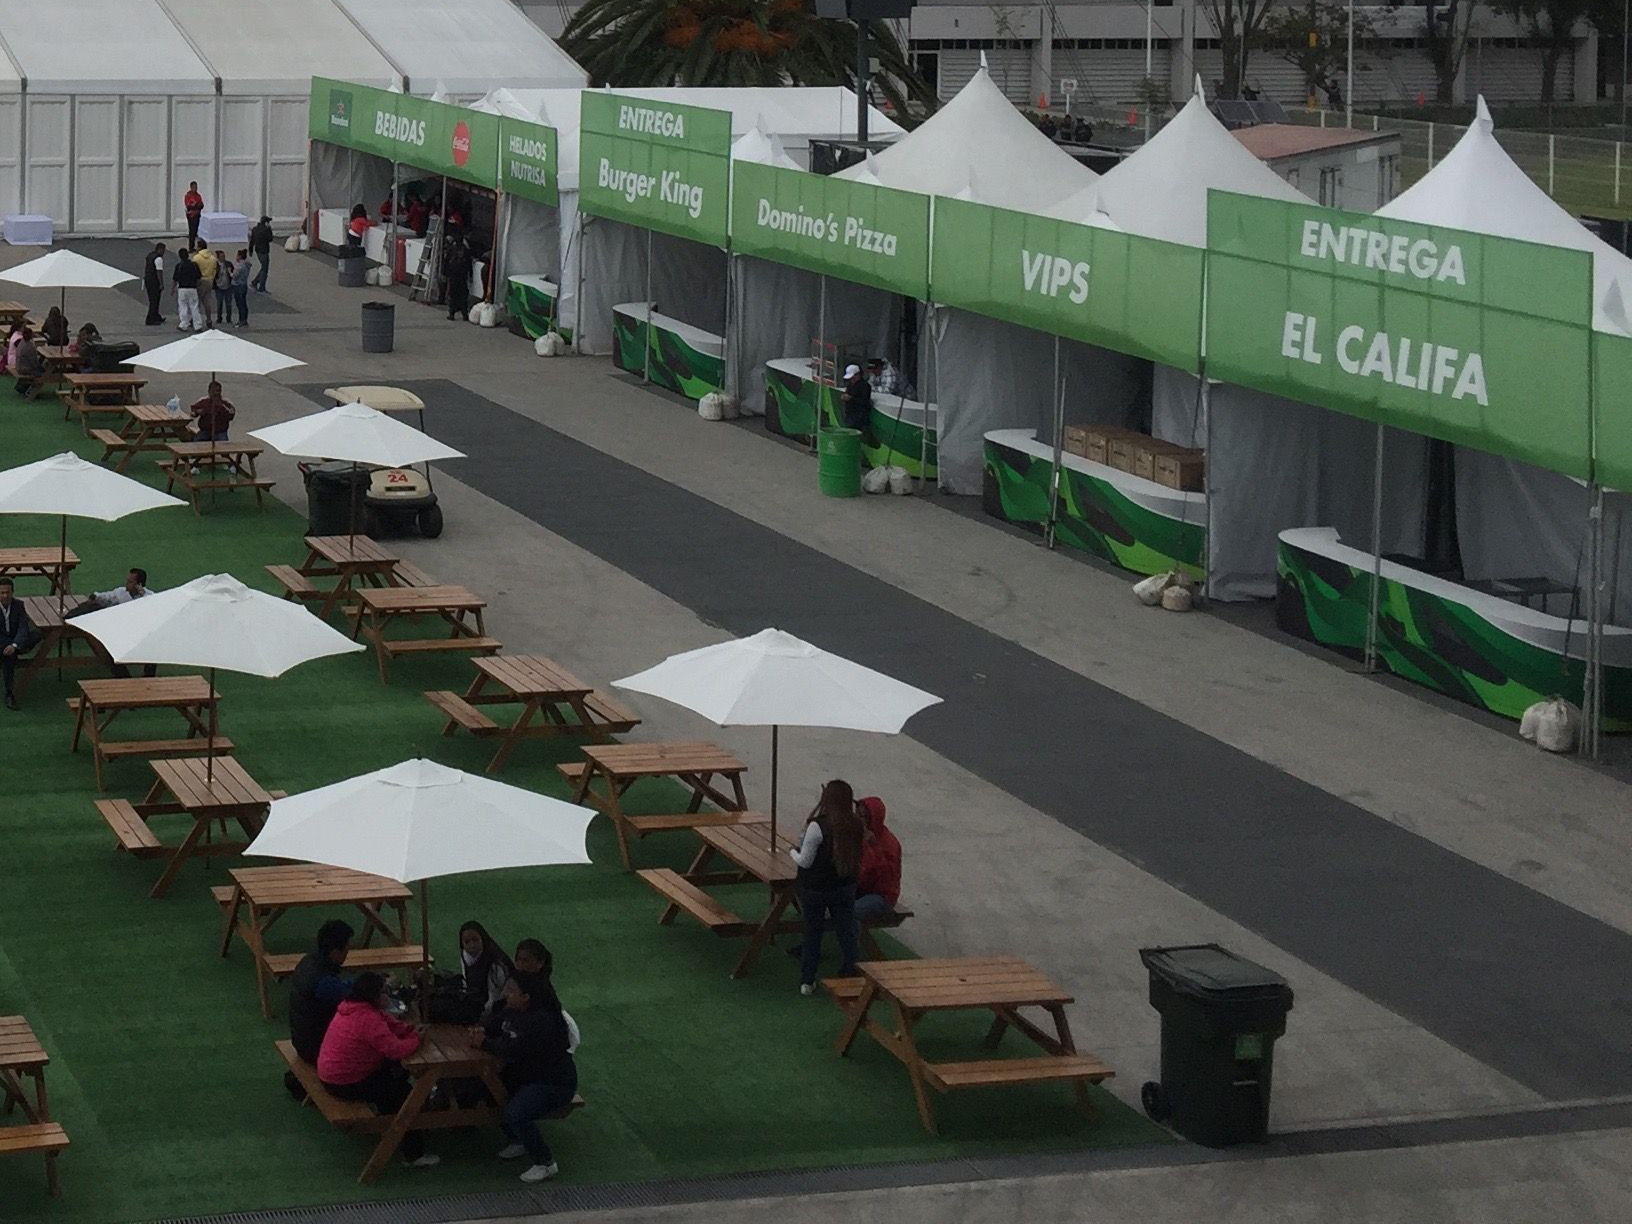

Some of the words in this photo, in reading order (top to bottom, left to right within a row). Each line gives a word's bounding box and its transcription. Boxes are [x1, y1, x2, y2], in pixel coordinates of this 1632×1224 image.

[375, 111, 426, 146] BEBIDAS
[619, 105, 684, 138] ENTREGA
[509, 134, 547, 161] HELADOS
[510, 160, 546, 188] NUTRISA
[598, 158, 656, 203] Burger
[660, 170, 703, 218] King
[757, 198, 838, 242] Domino's
[844, 216, 897, 257] Pizza
[1300, 219, 1466, 285] ENTREGA
[1022, 249, 1090, 304] VIPS
[1281, 311, 1322, 364] EL
[1336, 325, 1489, 406] CALIFA
[388, 474, 408, 483] 24
